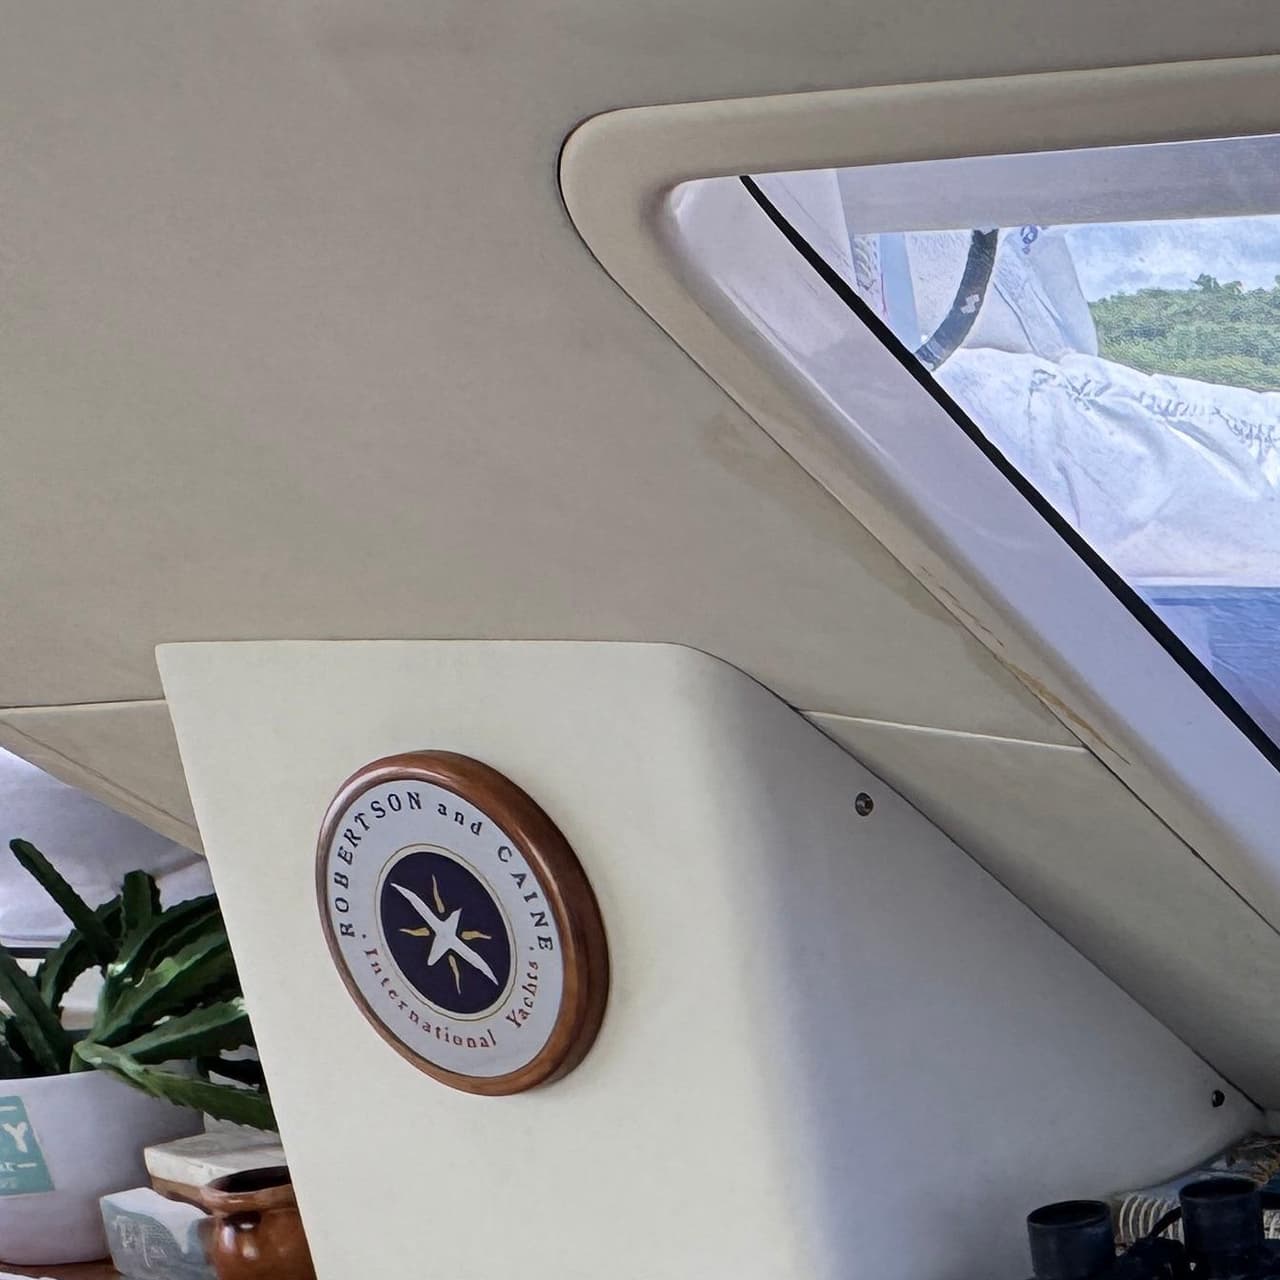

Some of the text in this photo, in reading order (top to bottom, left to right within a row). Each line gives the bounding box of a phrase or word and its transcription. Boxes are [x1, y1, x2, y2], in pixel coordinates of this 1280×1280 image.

[332, 791, 554, 952] ROBERTSON and CAINE
[364, 948, 541, 1049] International Yachts
